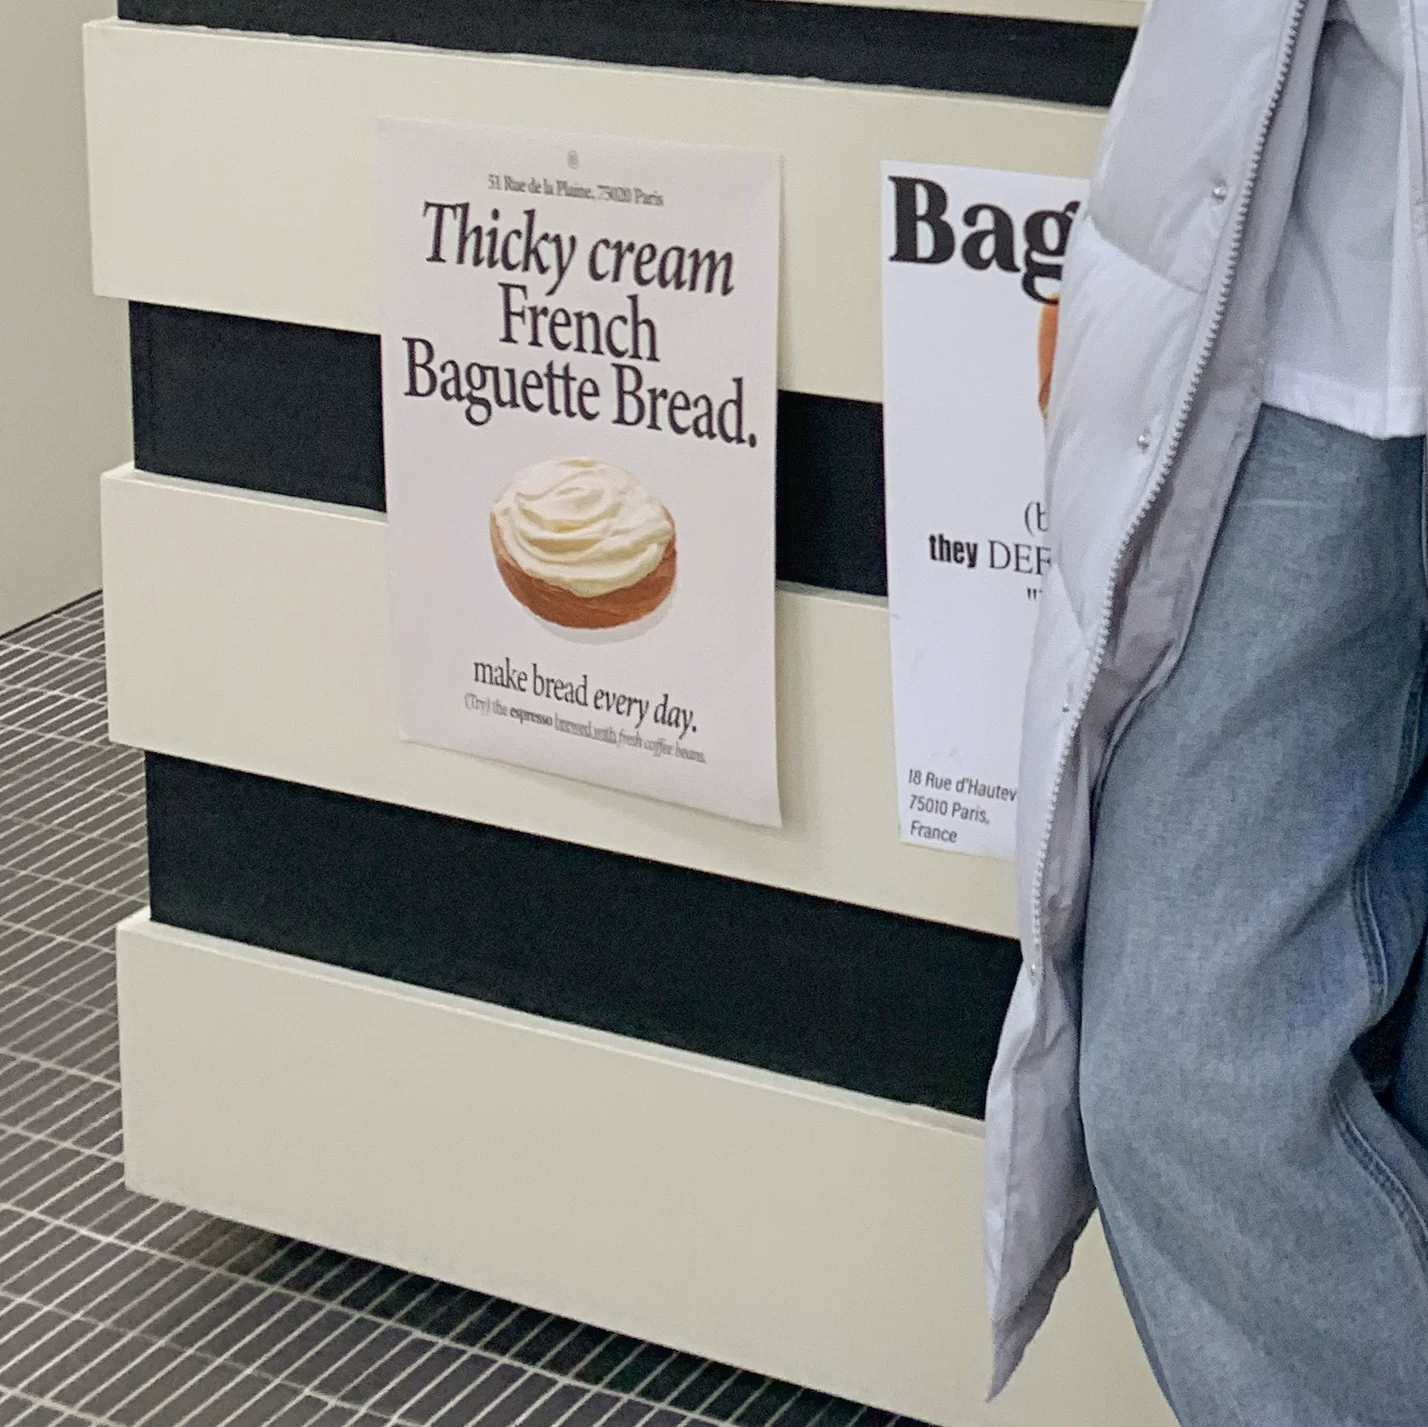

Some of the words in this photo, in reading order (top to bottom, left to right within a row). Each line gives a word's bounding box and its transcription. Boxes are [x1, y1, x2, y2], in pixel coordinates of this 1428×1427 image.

[503, 175, 526, 193] Rue
[527, 177, 541, 194] de
[634, 187, 664, 207] Paris
[423, 200, 577, 296] Thicky
[588, 237, 734, 296] cream
[888, 175, 1081, 306] Bag
[498, 281, 661, 362] French
[402, 336, 600, 427] Baguette
[610, 363, 758, 448] Bread.
[928, 533, 978, 569] they
[474, 657, 528, 692] make
[531, 663, 588, 707] bread
[594, 688, 649, 729] every
[653, 693, 697, 740] day.
[492, 701, 508, 716] the
[509, 706, 553, 725] espresso
[643, 736, 675, 758] coffee
[907, 768, 922, 786] 18
[925, 771, 952, 792] Rue
[909, 794, 948, 817] 75010
[951, 801, 990, 826] Paris,
[910, 819, 958, 844] France
